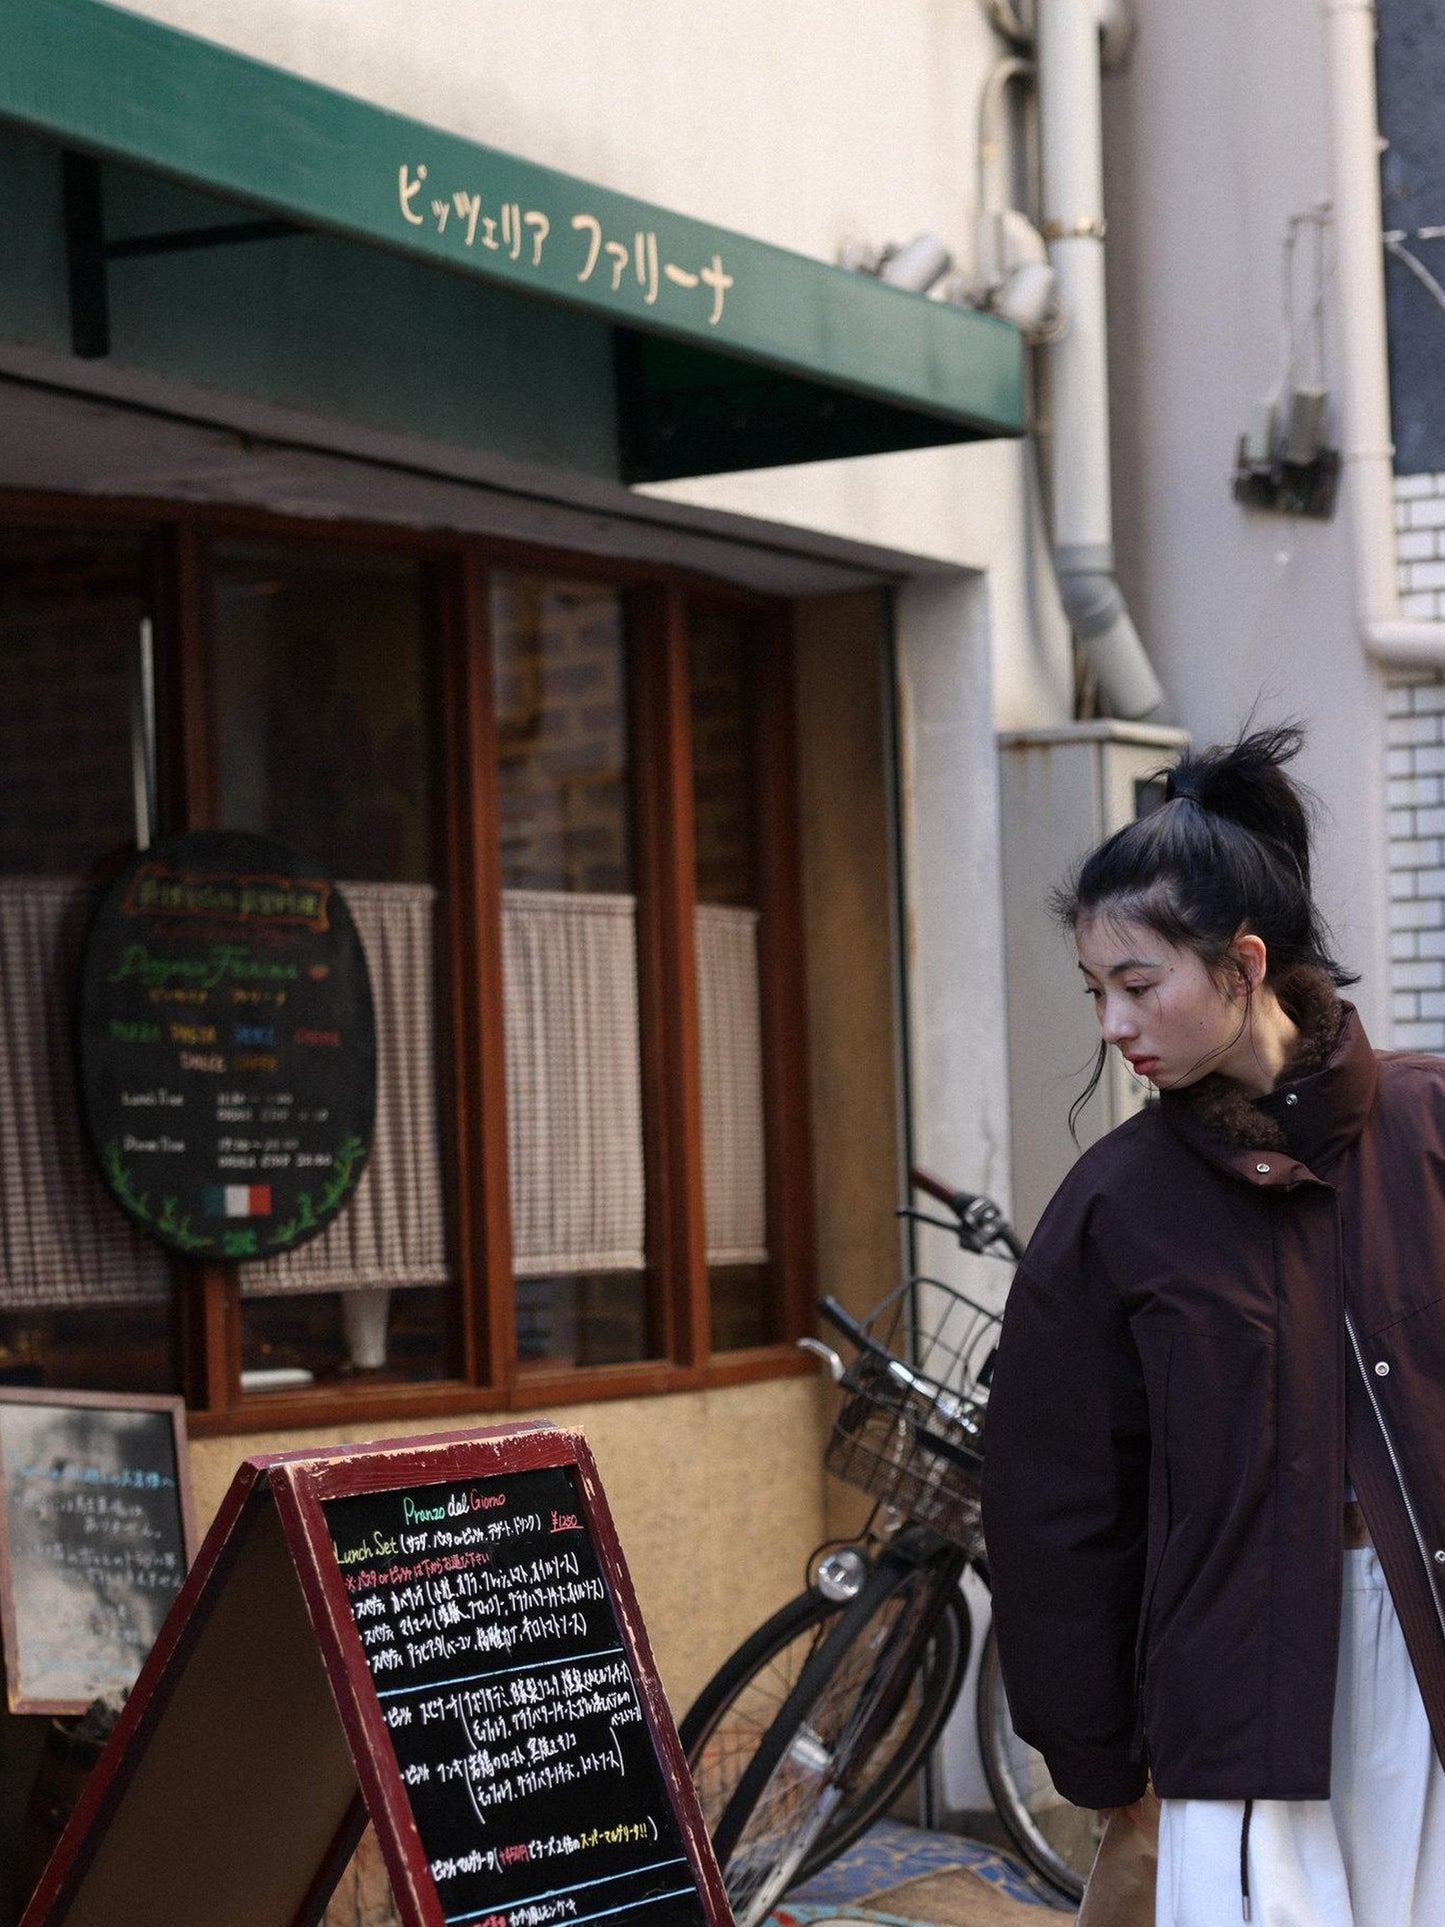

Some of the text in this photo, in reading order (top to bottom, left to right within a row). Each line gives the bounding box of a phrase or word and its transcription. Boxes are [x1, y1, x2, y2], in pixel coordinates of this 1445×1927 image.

[399, 163, 734, 325] ピッツェリア ファリーナ
[403, 1488, 506, 1525] Pranzo del Giorno
[333, 1539, 374, 1564] Lunch
[374, 1531, 398, 1556] Set
